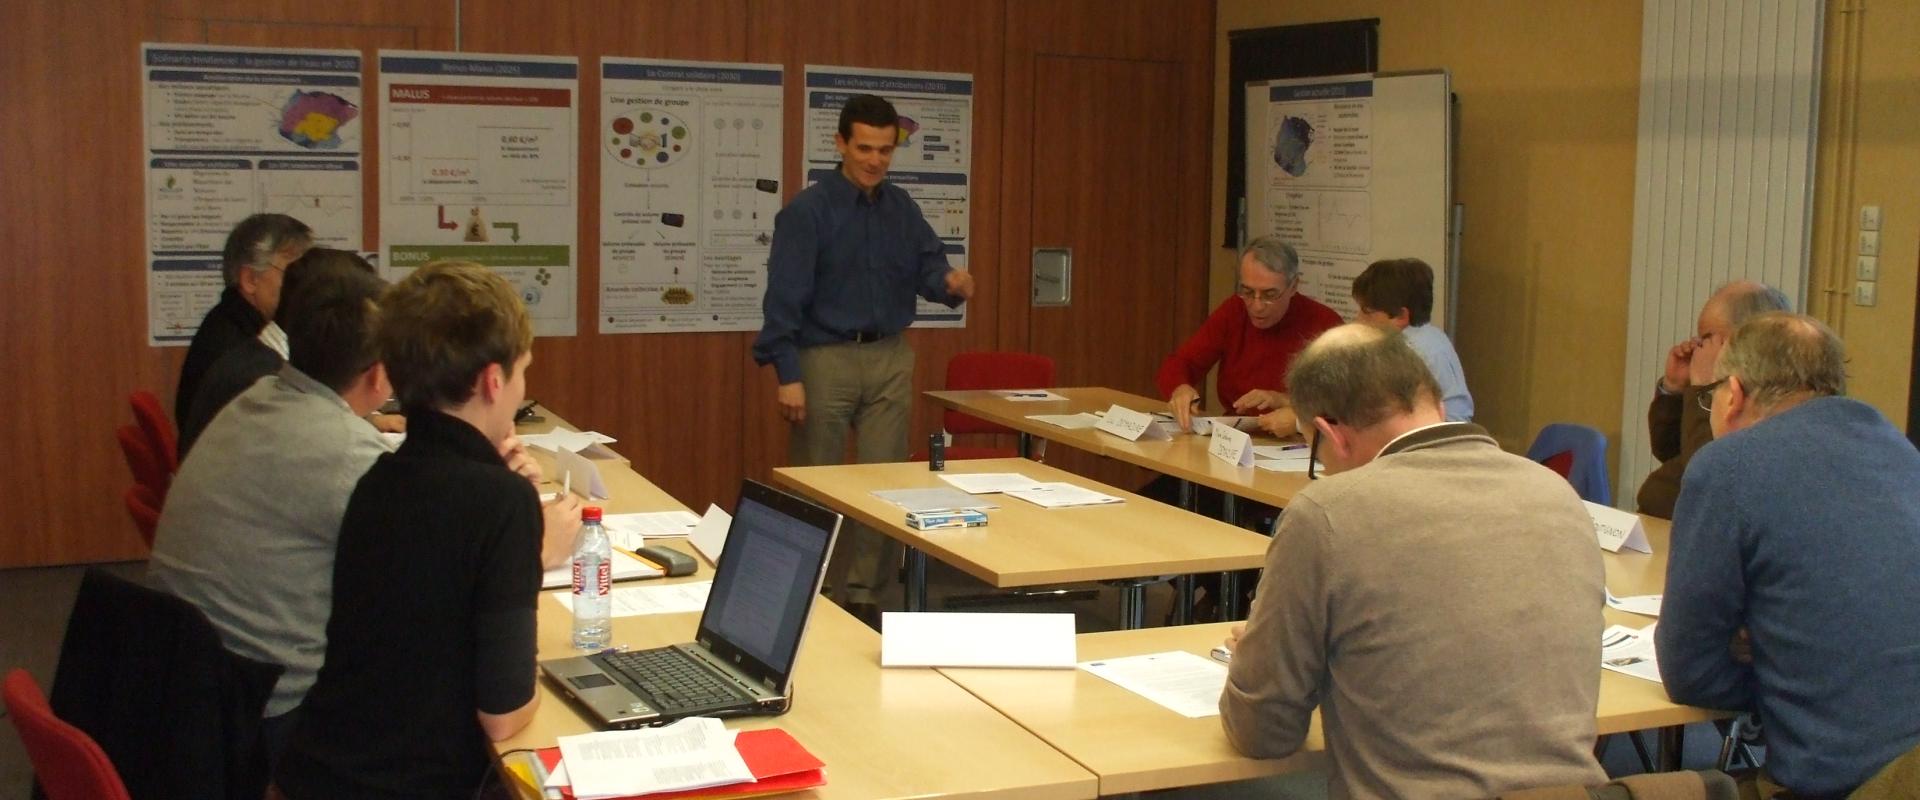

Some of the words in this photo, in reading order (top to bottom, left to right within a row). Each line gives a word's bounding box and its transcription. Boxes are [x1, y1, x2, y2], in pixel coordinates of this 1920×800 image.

[392, 89, 430, 99] MALUS
[626, 97, 653, 106] gestion
[654, 97, 662, 105] de
[664, 98, 690, 107] groupe
[392, 252, 430, 262] BONUS
[598, 562, 610, 597] Vittel
